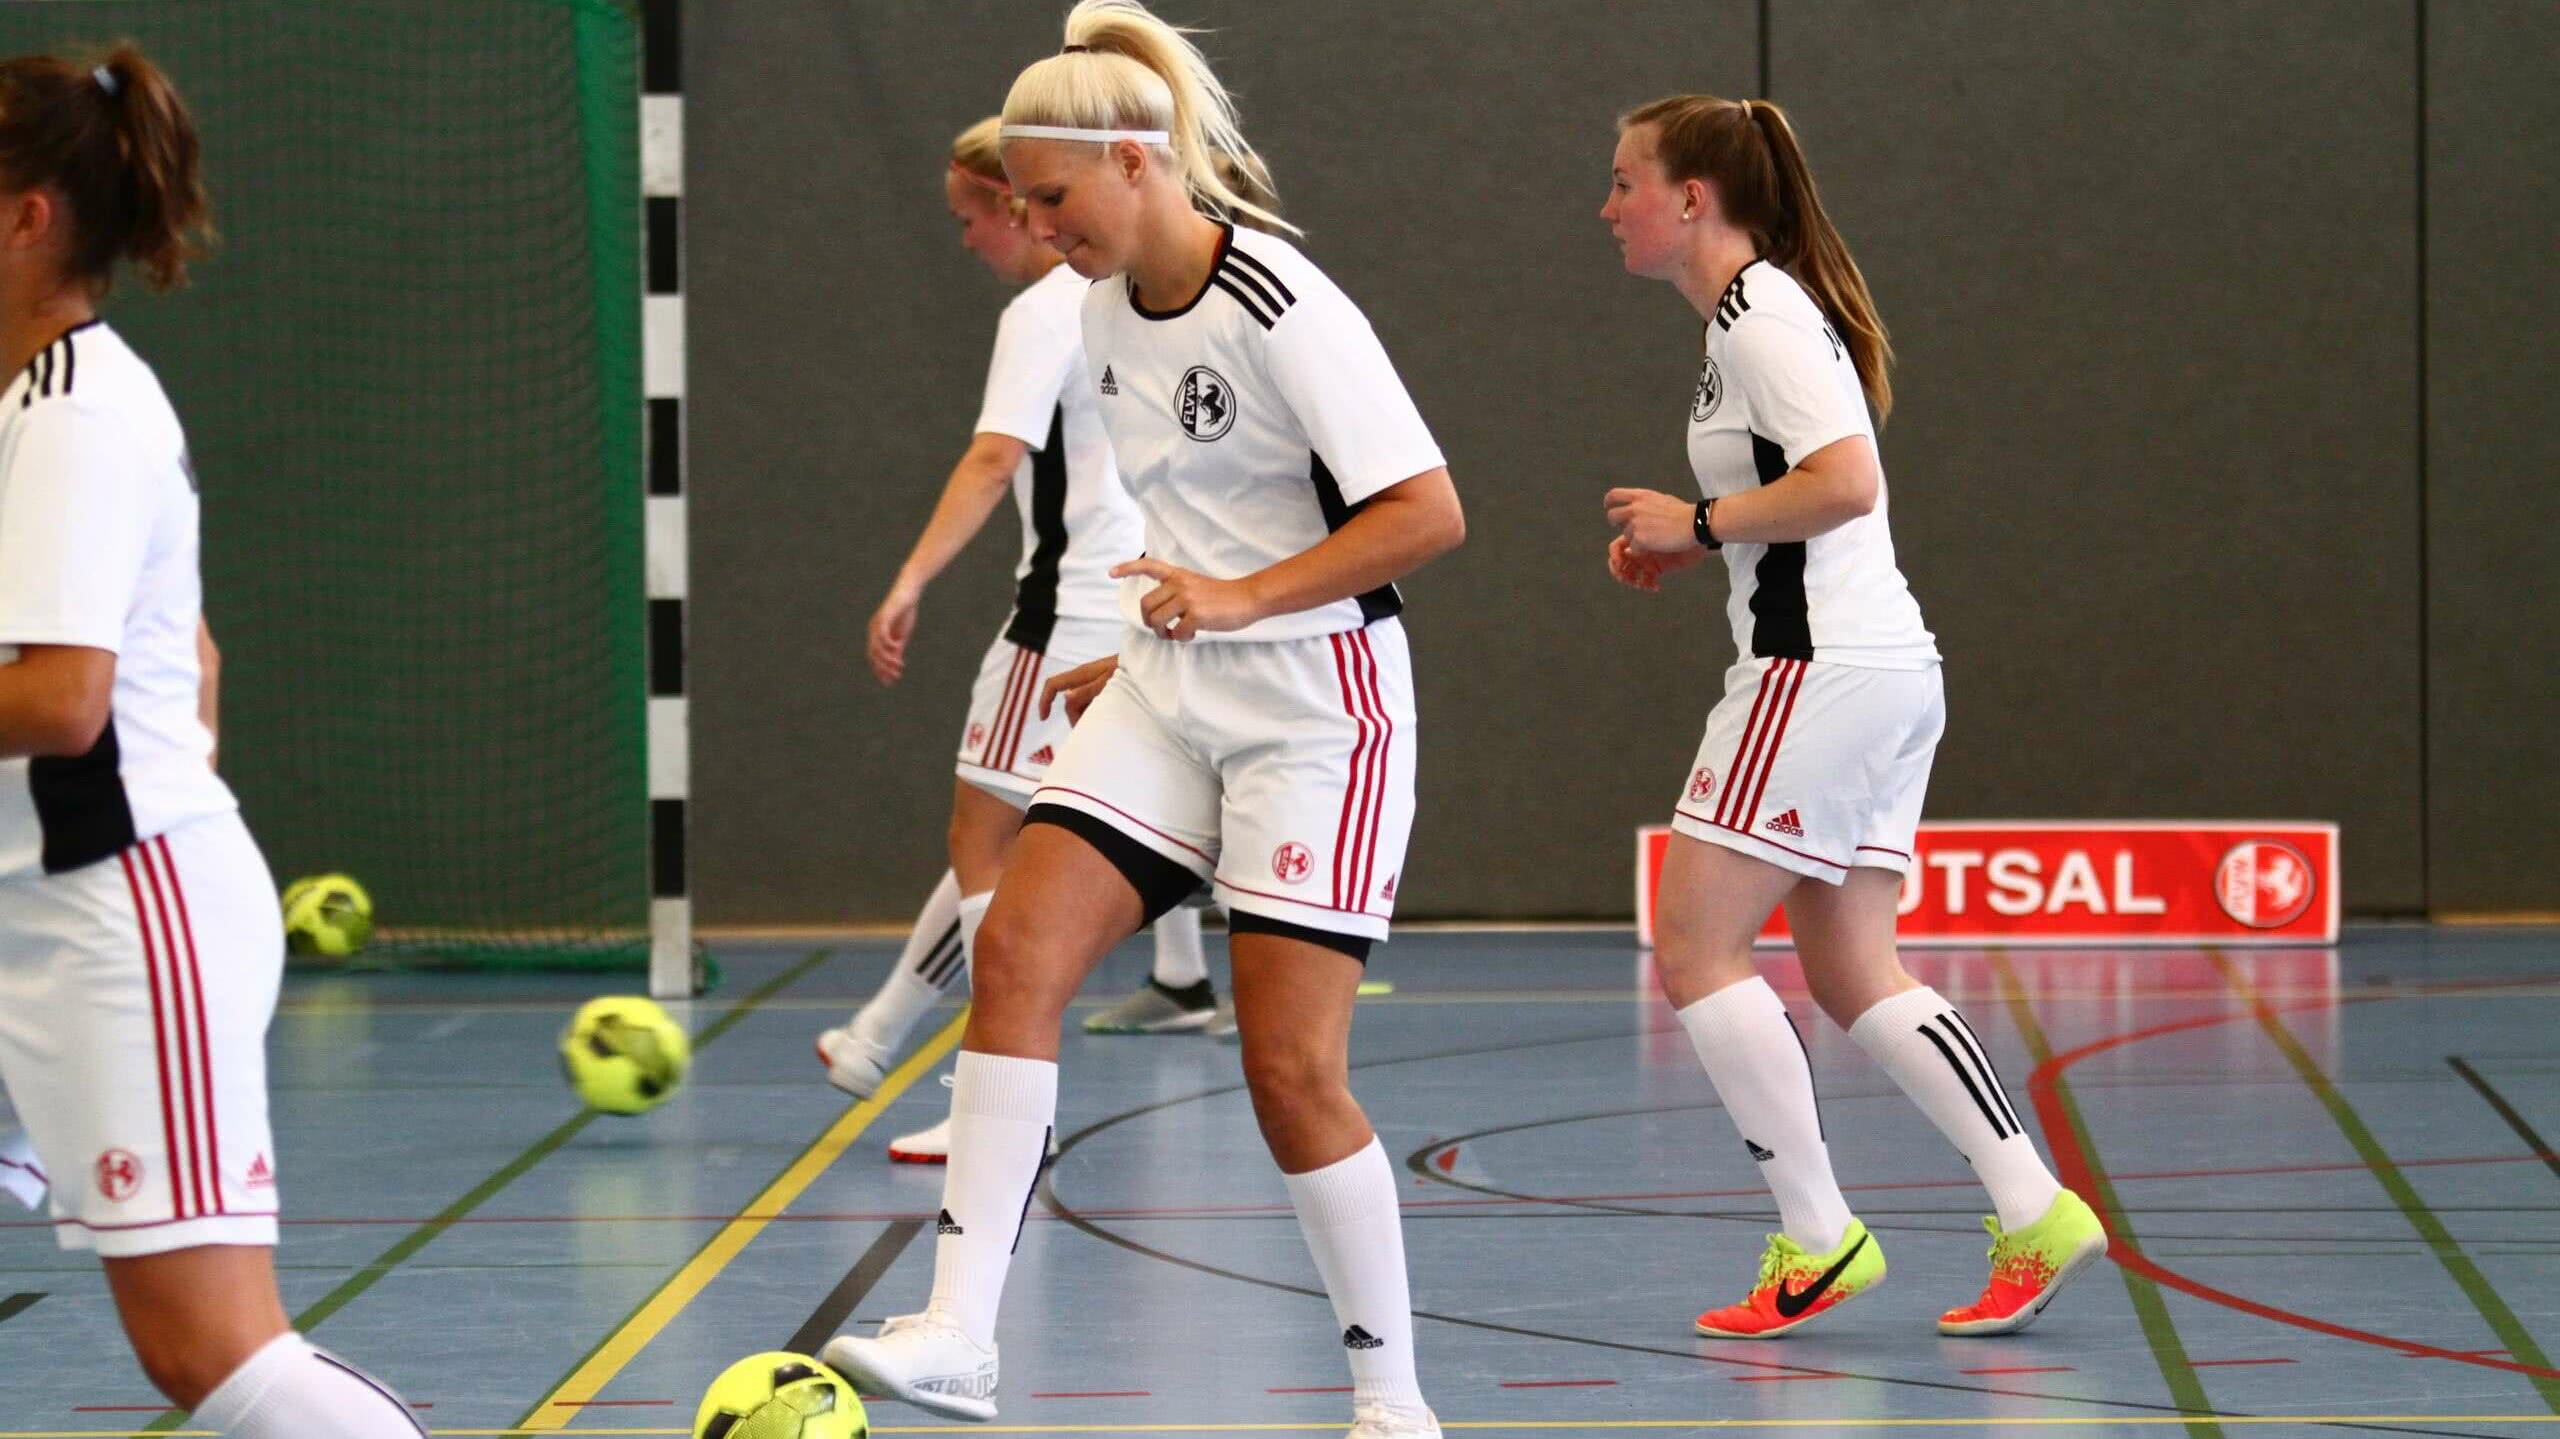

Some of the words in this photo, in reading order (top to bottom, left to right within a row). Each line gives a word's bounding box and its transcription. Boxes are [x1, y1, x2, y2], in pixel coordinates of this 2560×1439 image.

[1183, 382, 1196, 426] FLVW
[1765, 820, 1804, 838] adidas
[1897, 849, 2168, 915] TSAL
